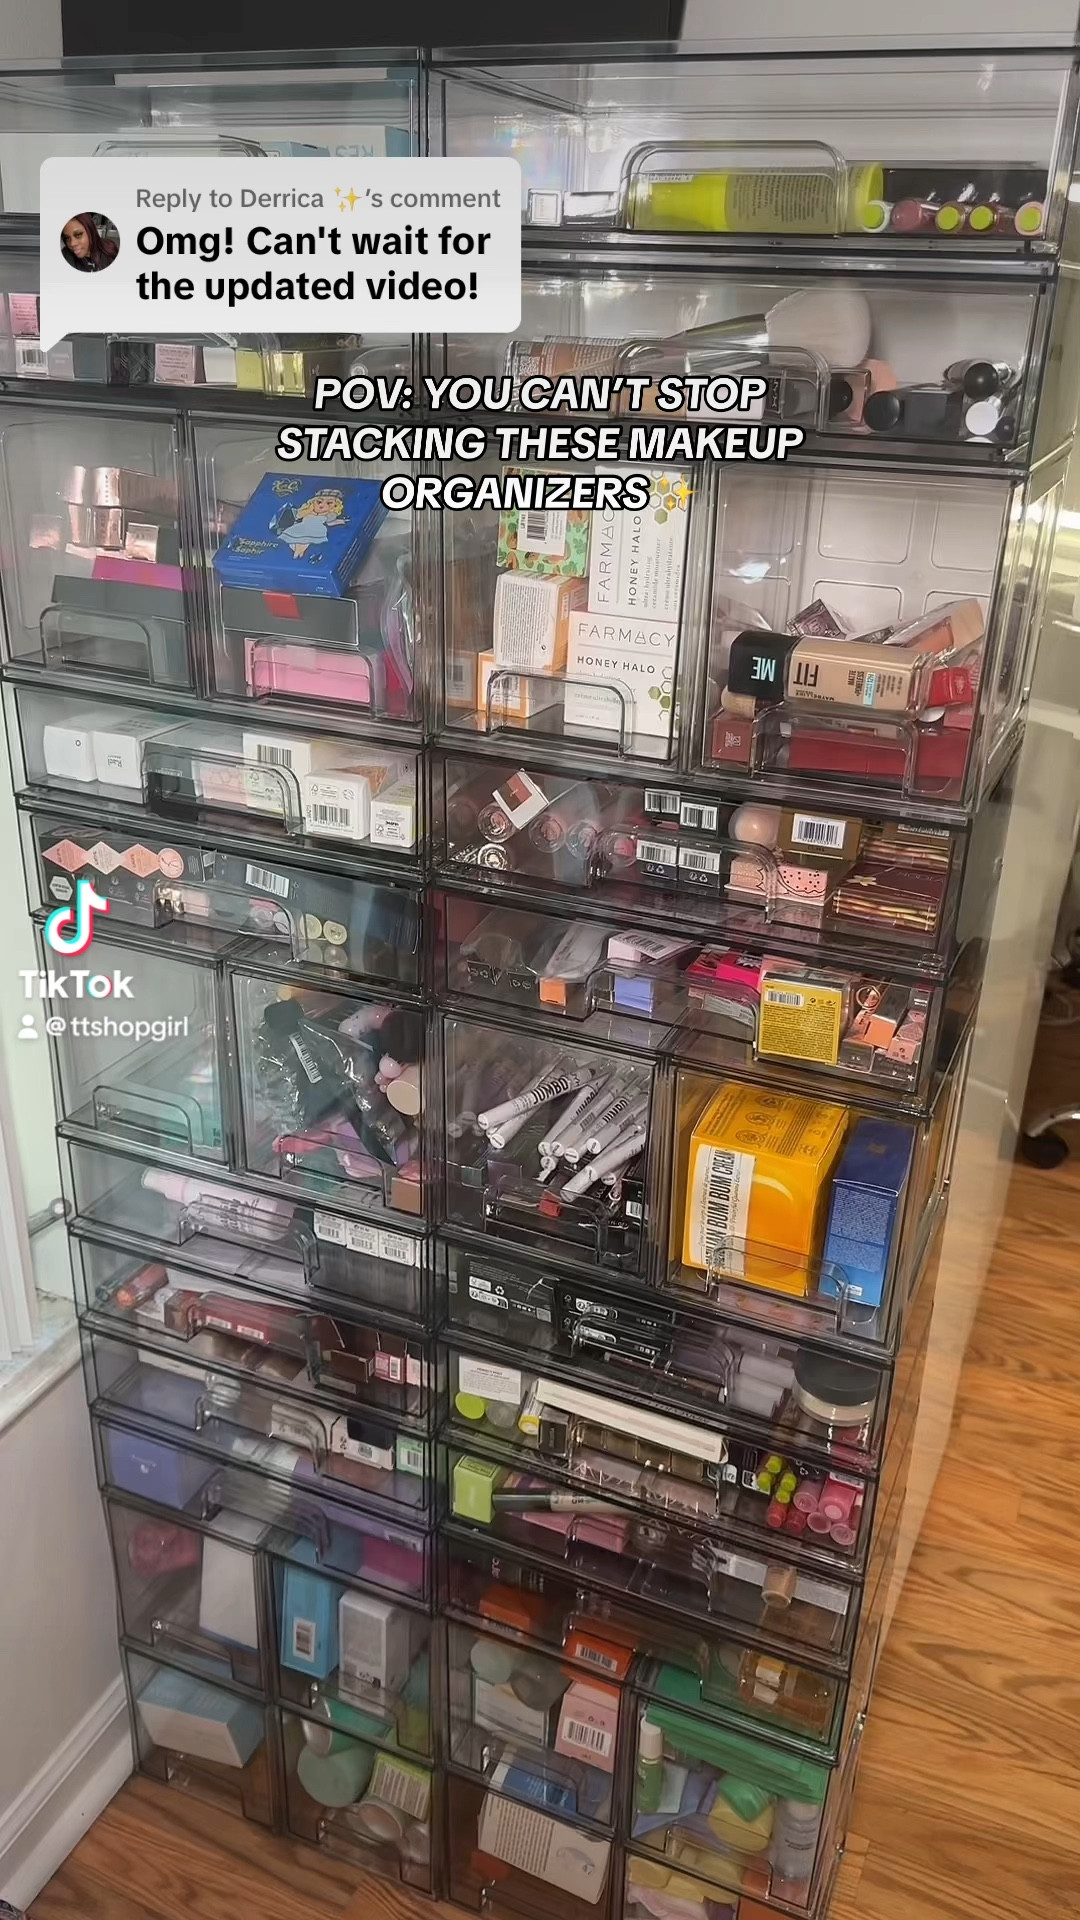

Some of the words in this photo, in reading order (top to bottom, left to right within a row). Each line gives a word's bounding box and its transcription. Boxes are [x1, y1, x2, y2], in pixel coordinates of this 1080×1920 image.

[238, 537, 279, 549] Sapphire
[631, 515, 642, 554] HALO
[597, 509, 615, 604] FARMAC
[628, 558, 640, 606] HONEY
[577, 622, 675, 648] FARMACY
[577, 655, 618, 669] HONEY
[622, 661, 656, 674] HALO
[751, 655, 776, 682] ME
[793, 662, 819, 688] FIT
[847, 669, 856, 686] MATTE
[531, 1074, 570, 1105] JUMBO
[709, 1174, 733, 1201] BUM
[706, 1200, 730, 1229] BUM
